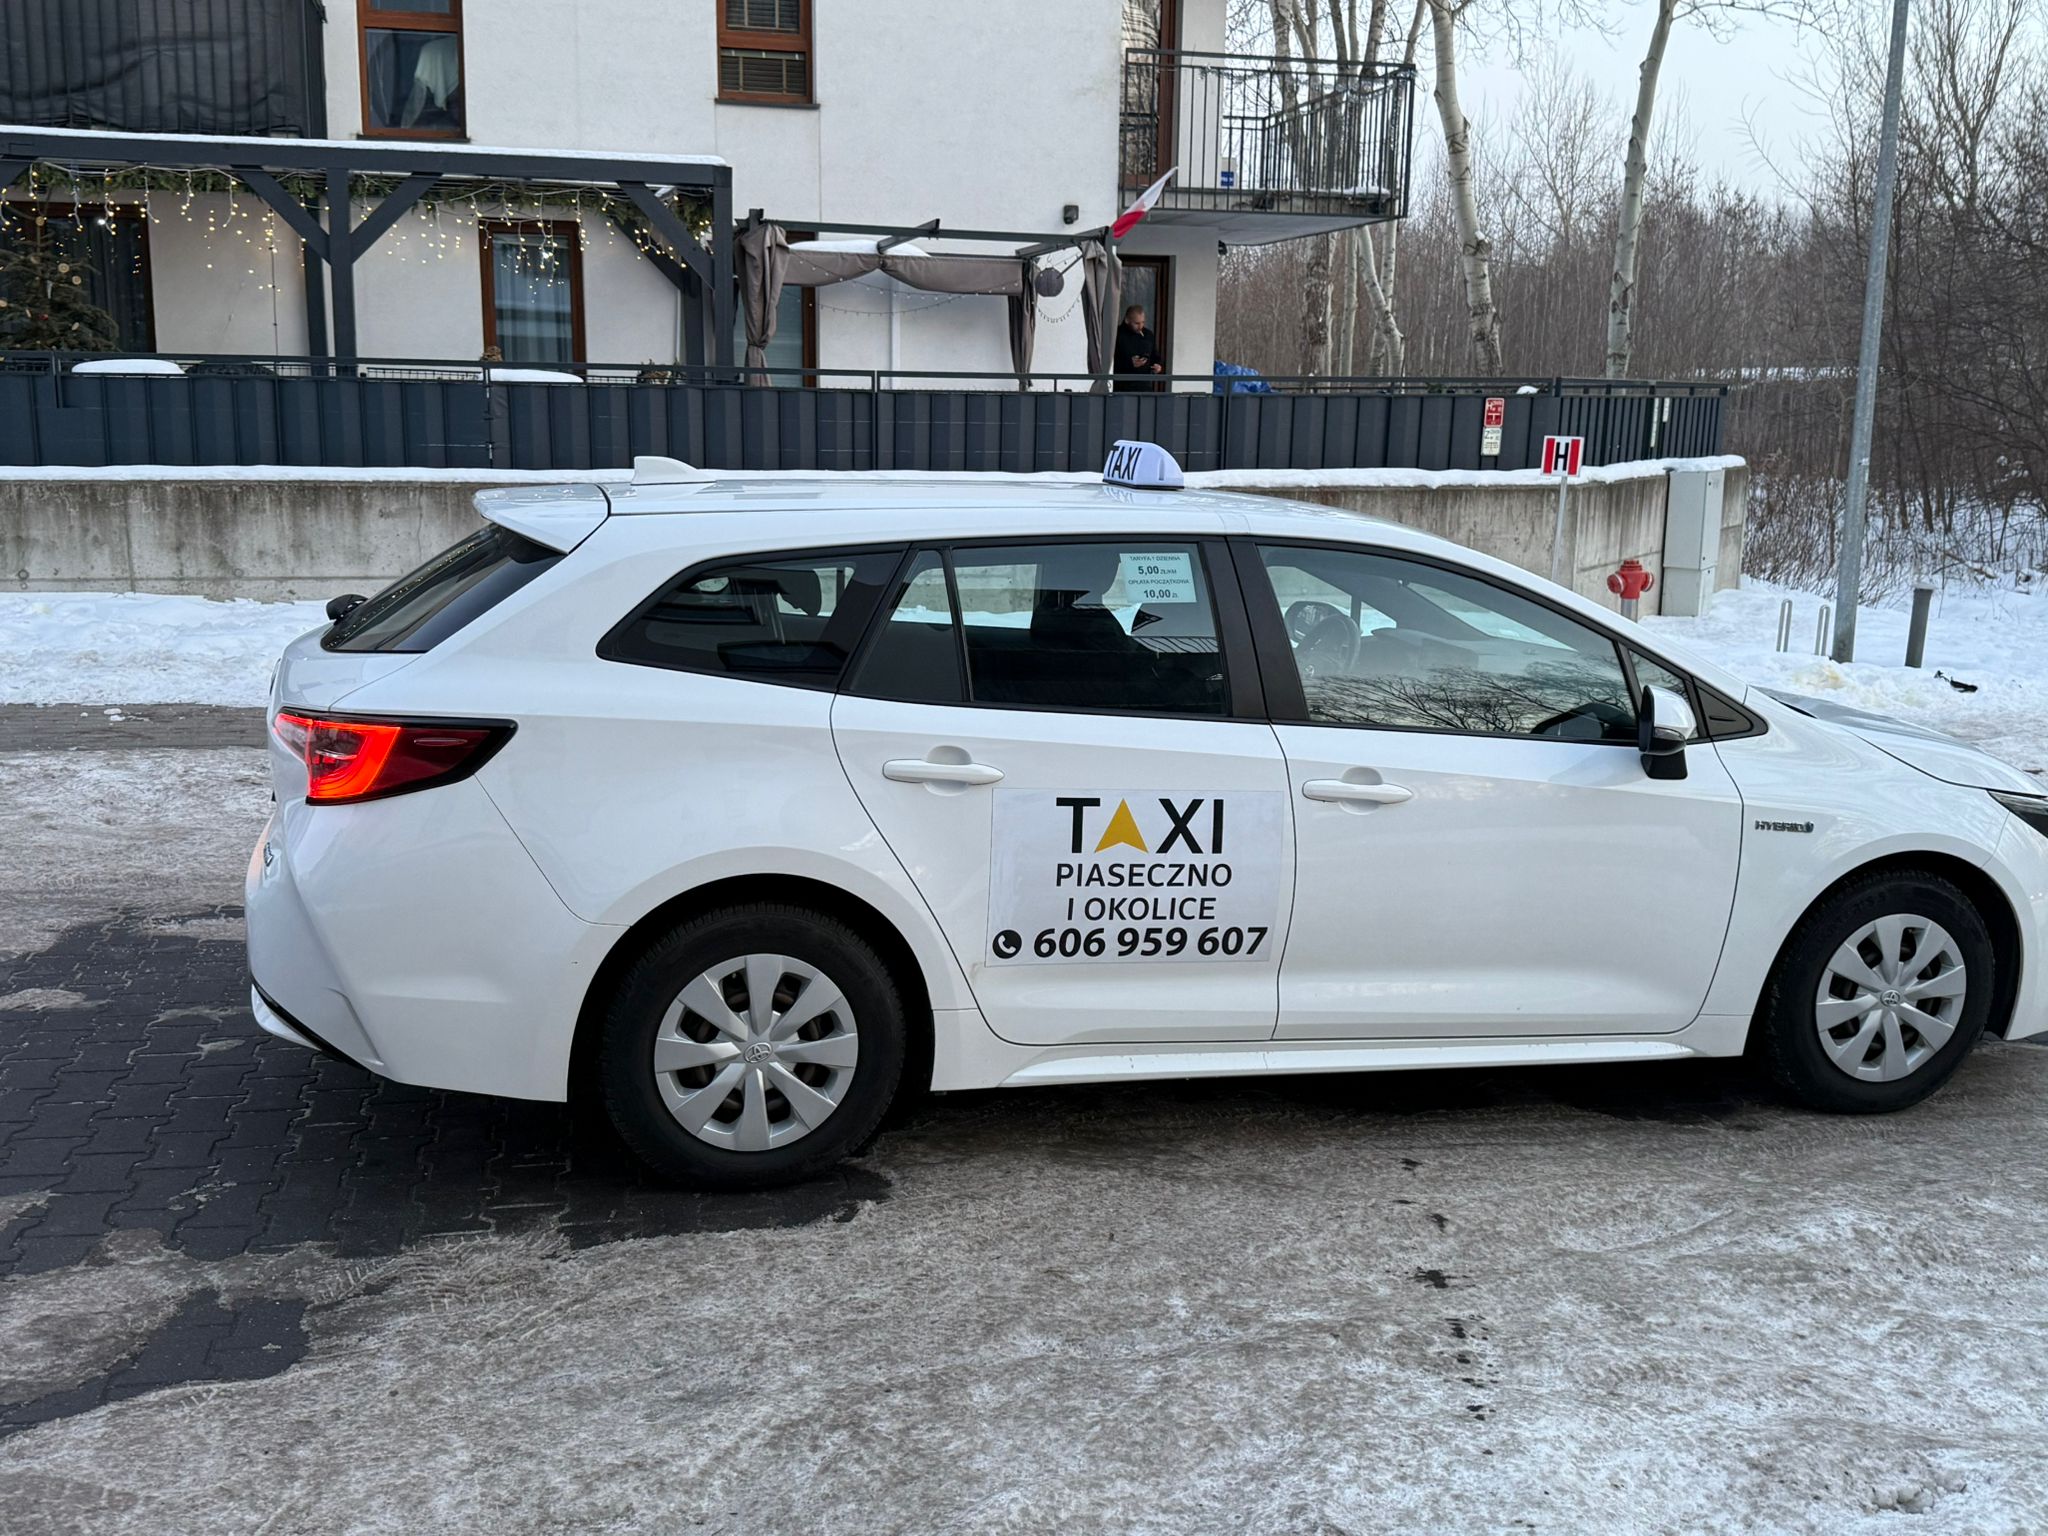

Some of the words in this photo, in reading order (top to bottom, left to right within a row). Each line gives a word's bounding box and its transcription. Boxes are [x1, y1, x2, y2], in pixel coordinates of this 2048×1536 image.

[1108, 445, 1142, 480] TAXI
[1554, 442, 1570, 471] H
[1138, 566, 1160, 575] 5,00
[1144, 589, 1171, 599] 10,00
[1056, 797, 1224, 854] TAXI
[1755, 820, 1804, 833] HYBRID
[1056, 863, 1232, 887] PIASECZNO
[1067, 898, 1074, 921] I
[1084, 897, 1217, 921] OKOLICE
[1033, 927, 1106, 958] 606
[1117, 927, 1188, 957] 959
[1197, 926, 1268, 956] 607
